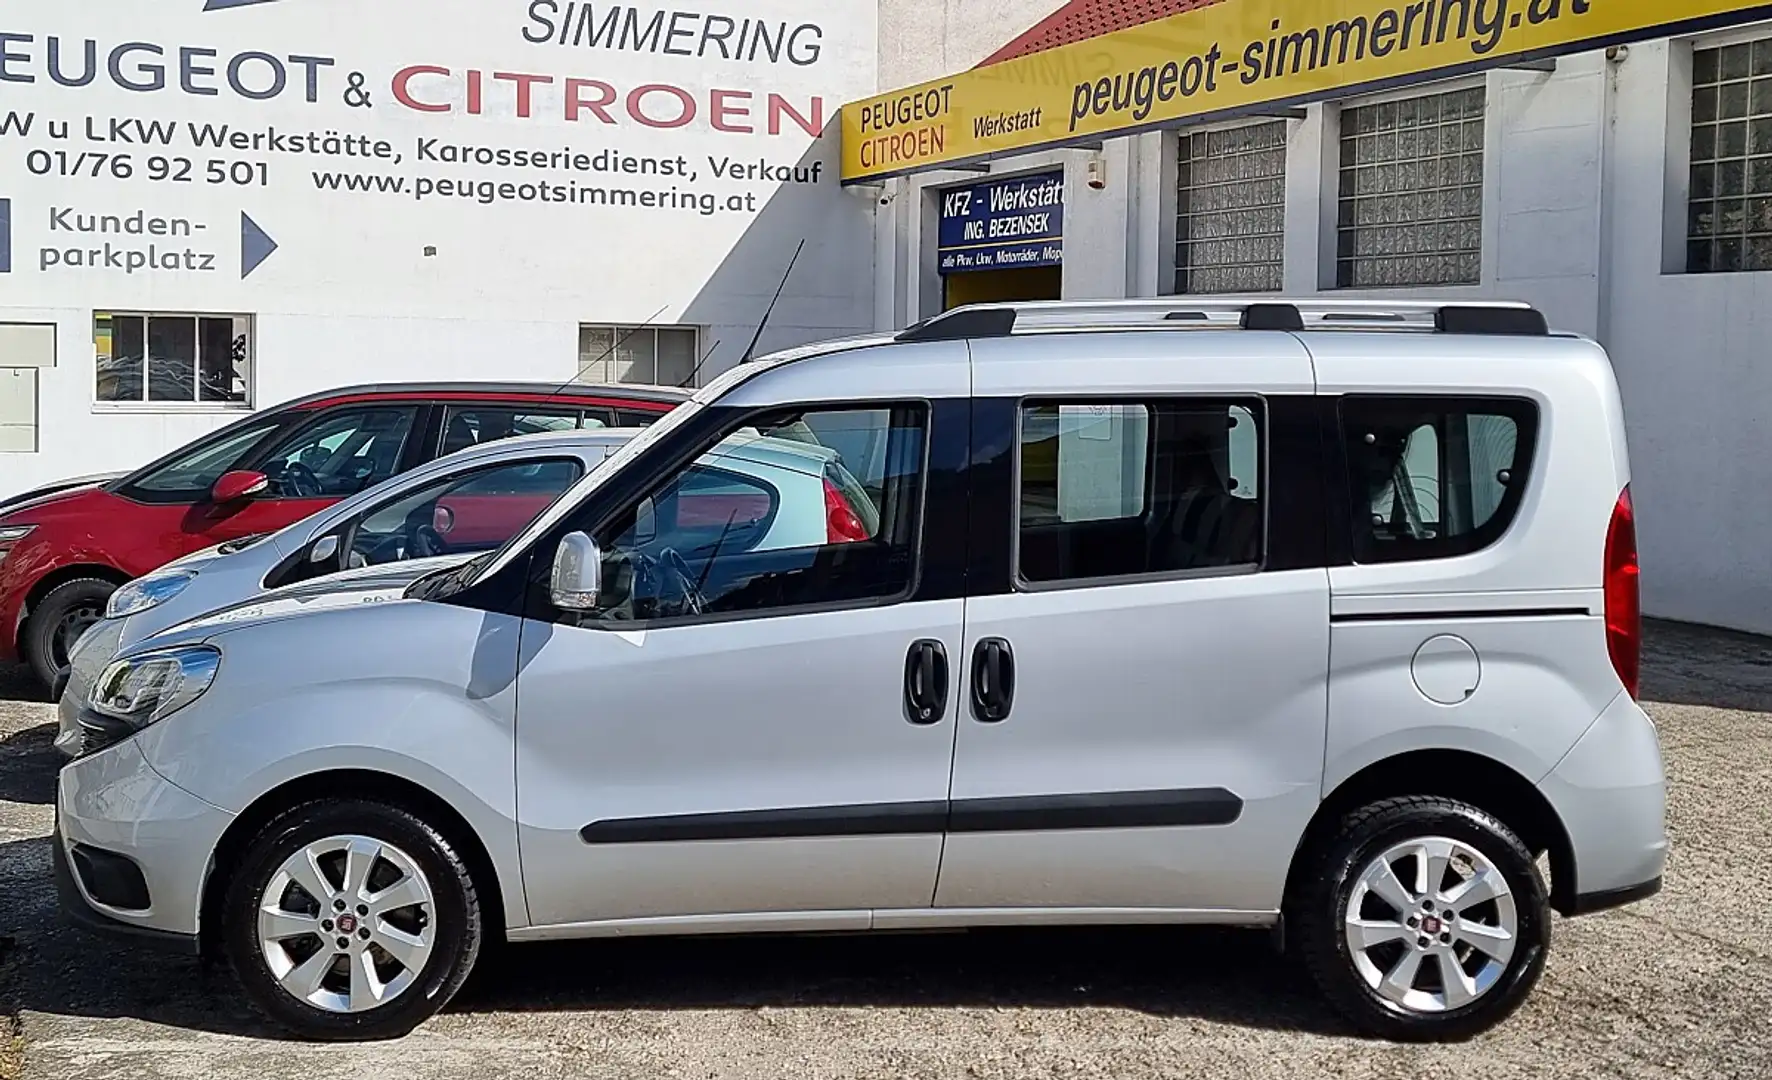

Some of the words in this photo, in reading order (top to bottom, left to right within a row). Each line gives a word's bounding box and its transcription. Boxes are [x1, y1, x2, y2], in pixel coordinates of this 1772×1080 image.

[522, 0, 823, 66] SIMMERING
[343, 72, 372, 108] &
[391, 65, 823, 138] CITROEN
[861, 85, 953, 133] PEUGEOT
[973, 107, 1042, 138] Werkstatt
[48, 121, 67, 139] u
[86, 116, 176, 145] LKW
[188, 123, 402, 165] Werkstätte,
[417, 138, 697, 183] Karosseriedienst,
[707, 155, 823, 183] Verkauf
[860, 125, 944, 168] CITROEN
[27, 150, 133, 179] 01/76
[147, 156, 192, 182] 92
[206, 160, 268, 187] 501
[312, 170, 757, 216] www.peugeotsimmering.at
[943, 190, 972, 218] KFZ
[50, 207, 206, 237] Kunden-
[964, 220, 985, 240] ING.
[989, 212, 1050, 238] BEZENSEK
[40, 243, 216, 273] parkplatz
